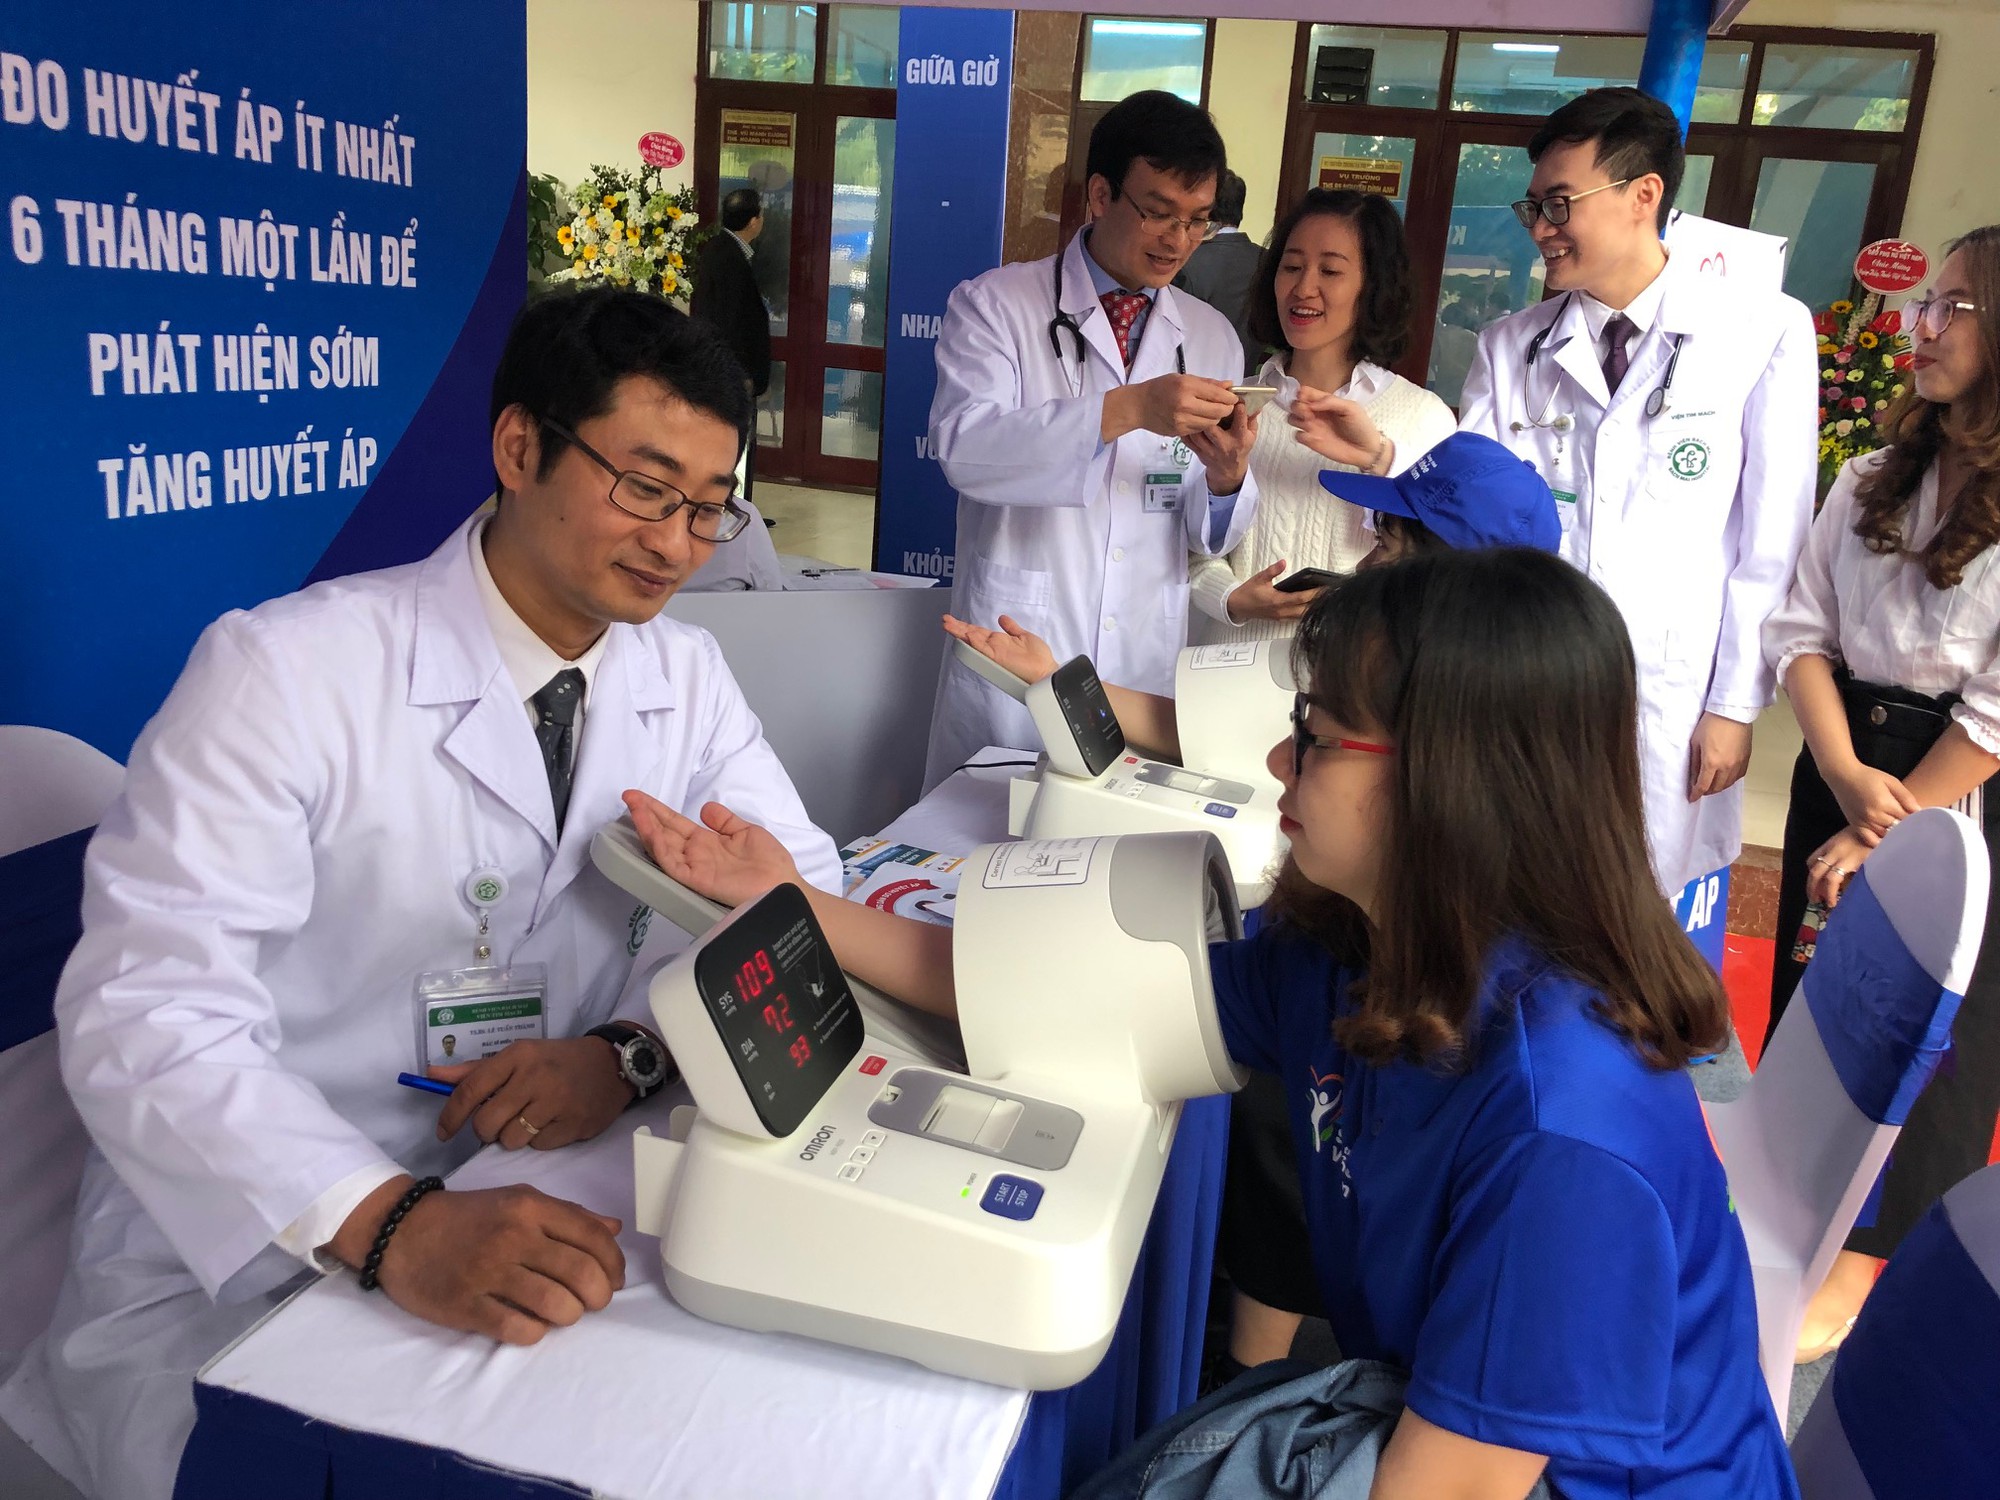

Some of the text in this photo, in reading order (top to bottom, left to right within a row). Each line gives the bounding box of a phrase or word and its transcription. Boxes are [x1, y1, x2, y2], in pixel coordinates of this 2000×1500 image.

[906, 54, 1000, 87] GIỮA GIỜ
[0, 52, 416, 188] ĐO HUYẾT ÁP ÍT NHẤT
[10, 191, 419, 292] 6 THÁNG MỘT LẦN ĐỂ
[87, 319, 379, 404] PHÁT HIỆN SỚM
[97, 424, 378, 520] TĂNG HUYẾT ÁP
[903, 547, 954, 577] KHỎE
[1685, 875, 1720, 932] ÁP
[735, 948, 775, 1003] 109
[718, 990, 734, 1010] SYS
[740, 1037, 756, 1056] DIA
[799, 1124, 837, 1161] OMRON
[994, 1182, 1012, 1203] START
[1014, 1188, 1029, 1206] STOP
